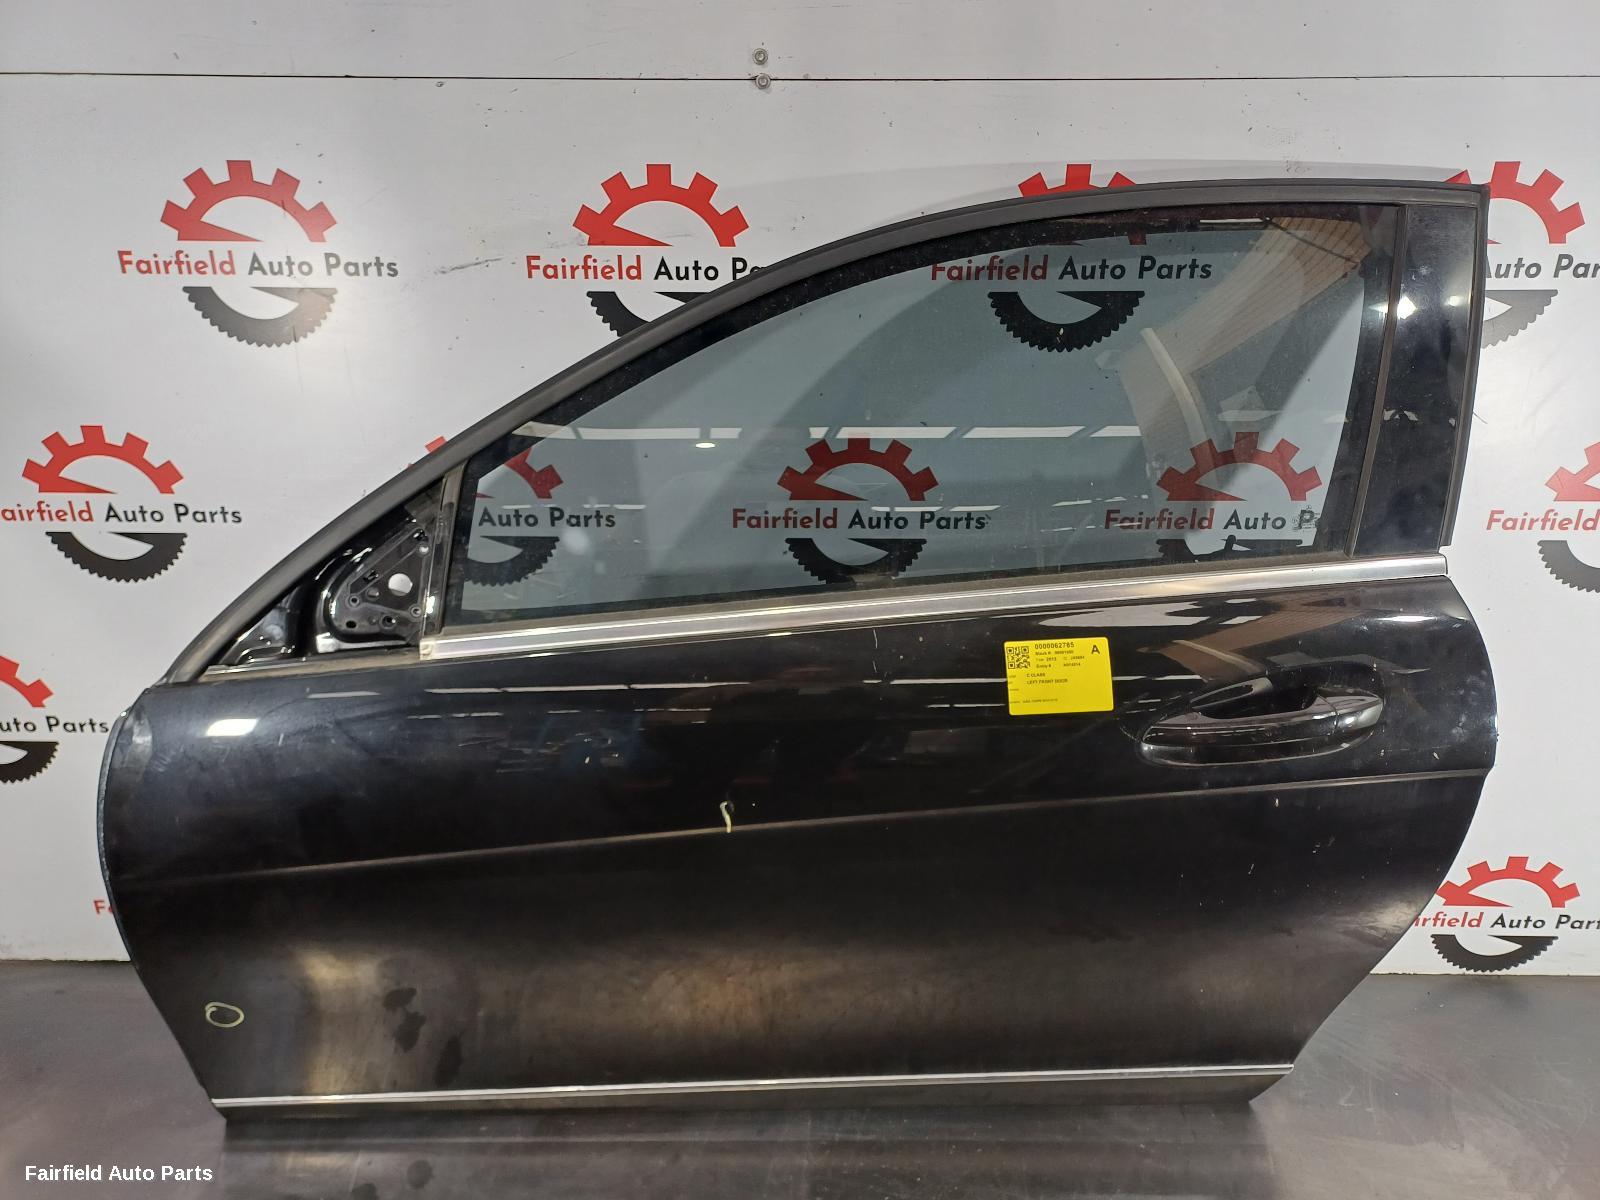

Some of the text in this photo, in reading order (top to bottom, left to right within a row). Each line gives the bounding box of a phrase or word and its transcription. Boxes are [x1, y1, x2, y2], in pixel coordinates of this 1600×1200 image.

[118, 250, 399, 278] Fairfield Auto Parts
[526, 255, 642, 280] Fairfield
[653, 256, 719, 281] Auto
[931, 254, 1212, 281] Fairfield Auto Parts
[105, 503, 164, 524] Auto
[174, 504, 243, 525] Parts
[478, 506, 616, 528] Auto Parts
[732, 507, 986, 531] Fairfield Auto Parts
[1104, 507, 1215, 531] Fairfield
[1223, 509, 1287, 530] Auto
[1486, 508, 1600, 531] Fairfield
[1091, 645, 1101, 654] A
[46, 716, 109, 733] Parts
[1414, 911, 1484, 928] irfield
[1490, 913, 1546, 929] Auto
